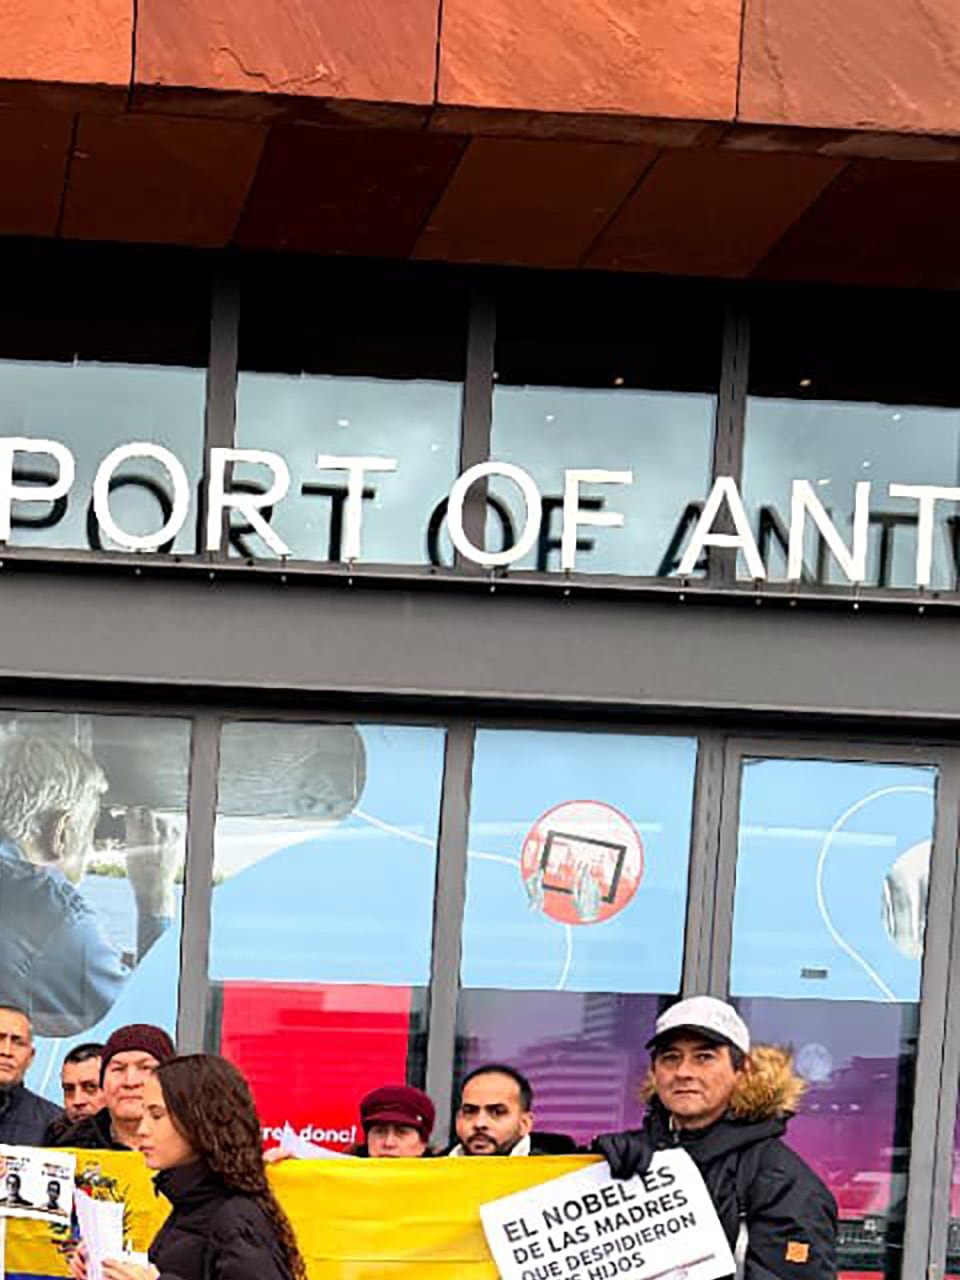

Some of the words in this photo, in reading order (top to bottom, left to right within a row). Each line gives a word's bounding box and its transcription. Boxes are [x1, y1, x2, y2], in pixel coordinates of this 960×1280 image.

[448, 461, 633, 569] OF
[503, 1218, 538, 1243] EL
[542, 1183, 636, 1230] NOBEL
[642, 1166, 676, 1193] ES
[513, 1241, 544, 1265] DE
[548, 1225, 590, 1253] LAS
[594, 1189, 688, 1236] MADRES
[566, 1212, 697, 1271] DESPIDIERON
